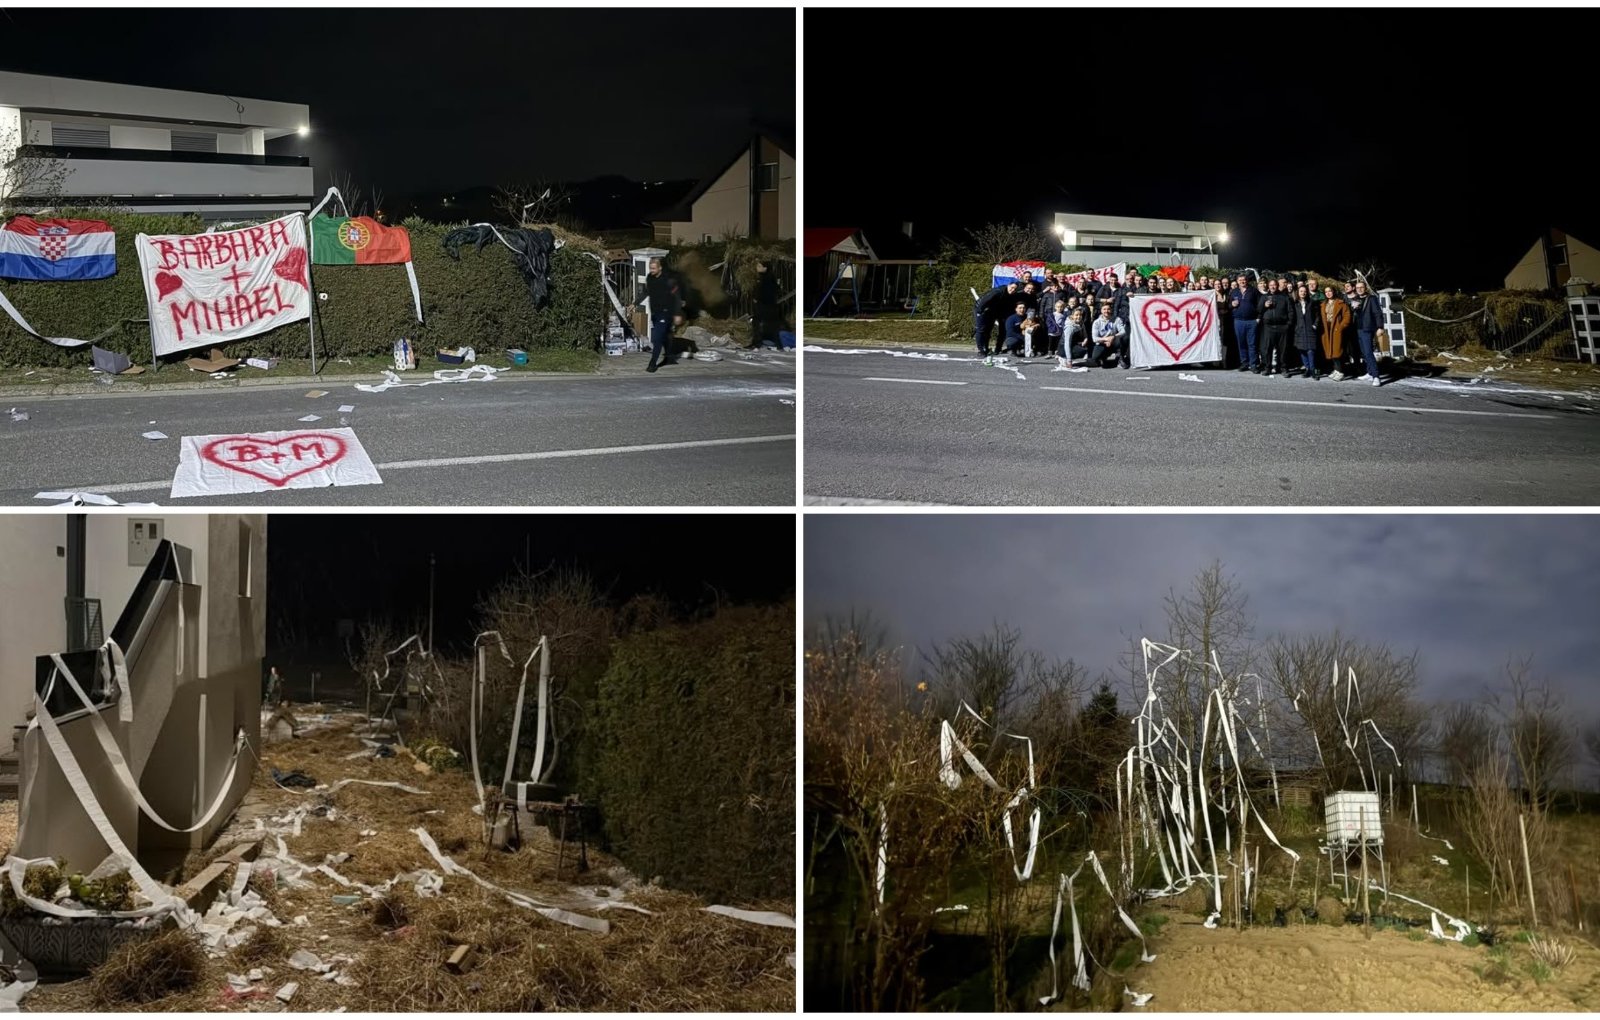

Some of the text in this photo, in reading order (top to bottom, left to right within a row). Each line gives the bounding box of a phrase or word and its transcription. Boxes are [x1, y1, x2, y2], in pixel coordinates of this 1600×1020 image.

[149, 220, 290, 271] BARBARA
[170, 282, 295, 341] MIHAEL
[1153, 308, 1201, 336] B+M
[227, 442, 326, 464] B+M
